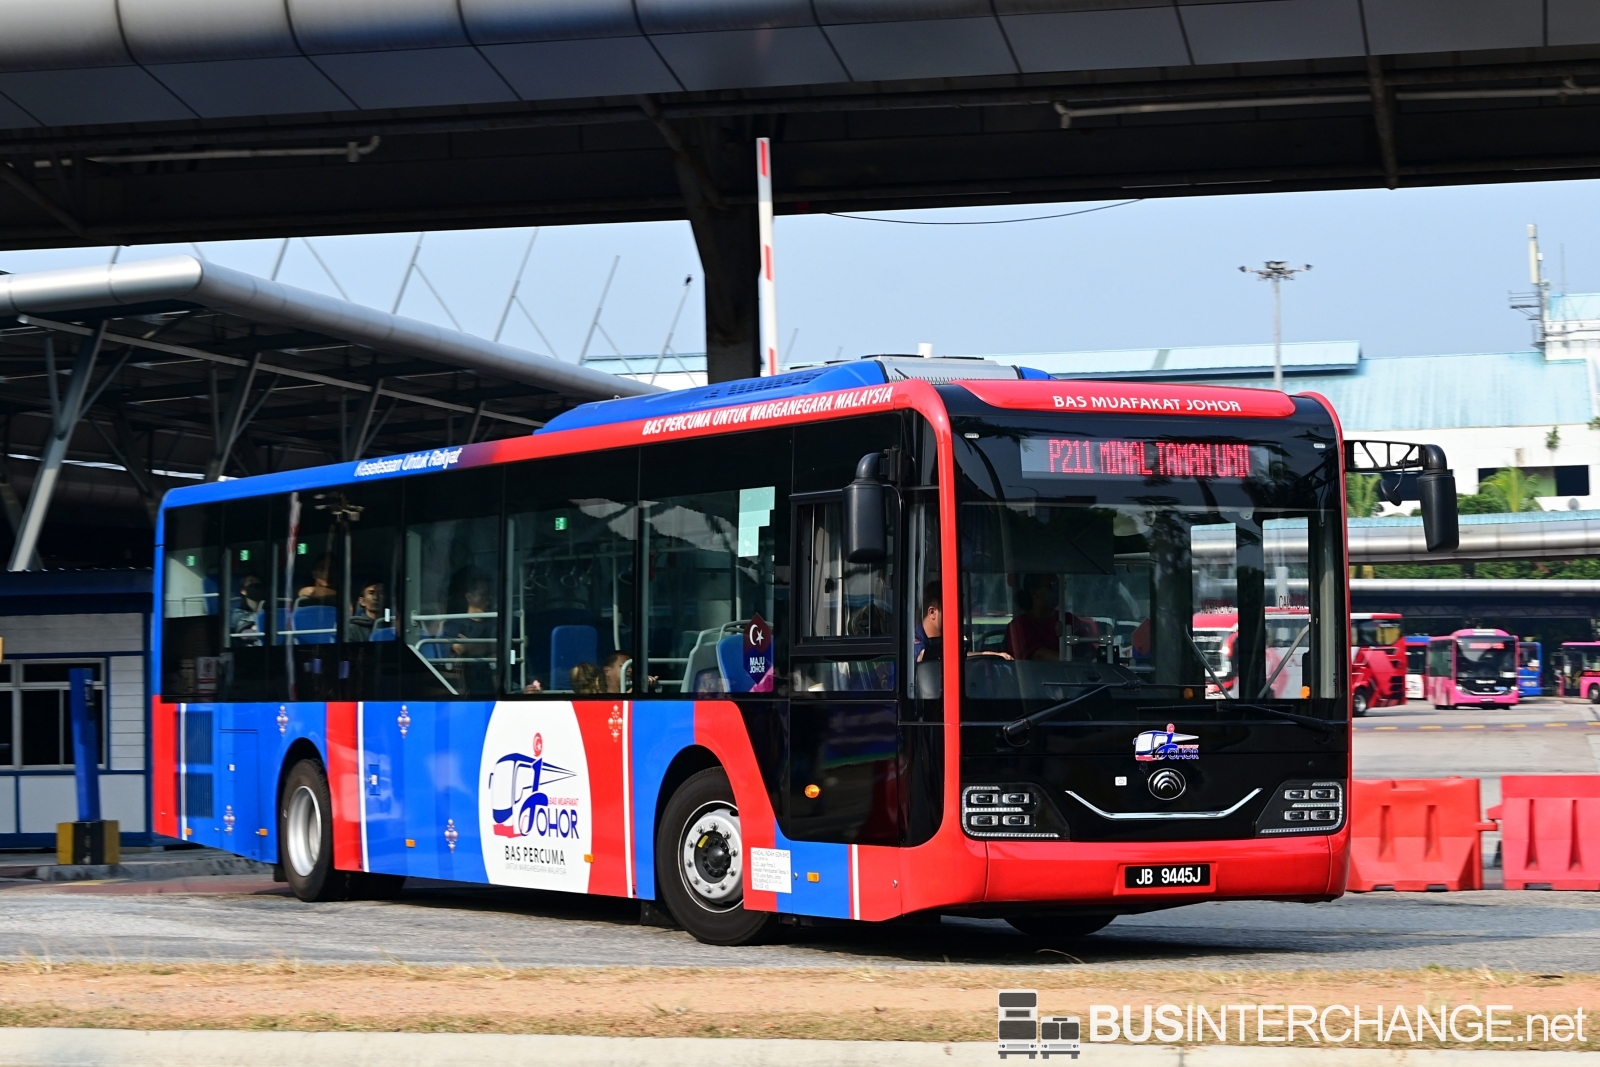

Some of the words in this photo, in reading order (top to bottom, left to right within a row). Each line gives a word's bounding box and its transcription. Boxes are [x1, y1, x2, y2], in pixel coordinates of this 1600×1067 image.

[642, 420, 663, 436] BAS
[662, 412, 712, 432] PERCUMA
[712, 406, 751, 426] UNTUK
[750, 395, 834, 421] WARGANEGARA
[834, 386, 894, 410] MALAYSIA
[1053, 395, 1087, 408] BAS
[1091, 396, 1180, 410] MUAFAKAT
[1186, 399, 1242, 412] JOHOR
[1048, 439, 1094, 473] P211
[1155, 442, 1212, 477] TAMAN
[749, 656, 766, 666] MAJU
[749, 665, 766, 674] JOHOR
[505, 845, 522, 861] BAS
[523, 846, 566, 866] PERCUMA
[1136, 868, 1154, 885] JB
[1161, 867, 1201, 884] 9445J
